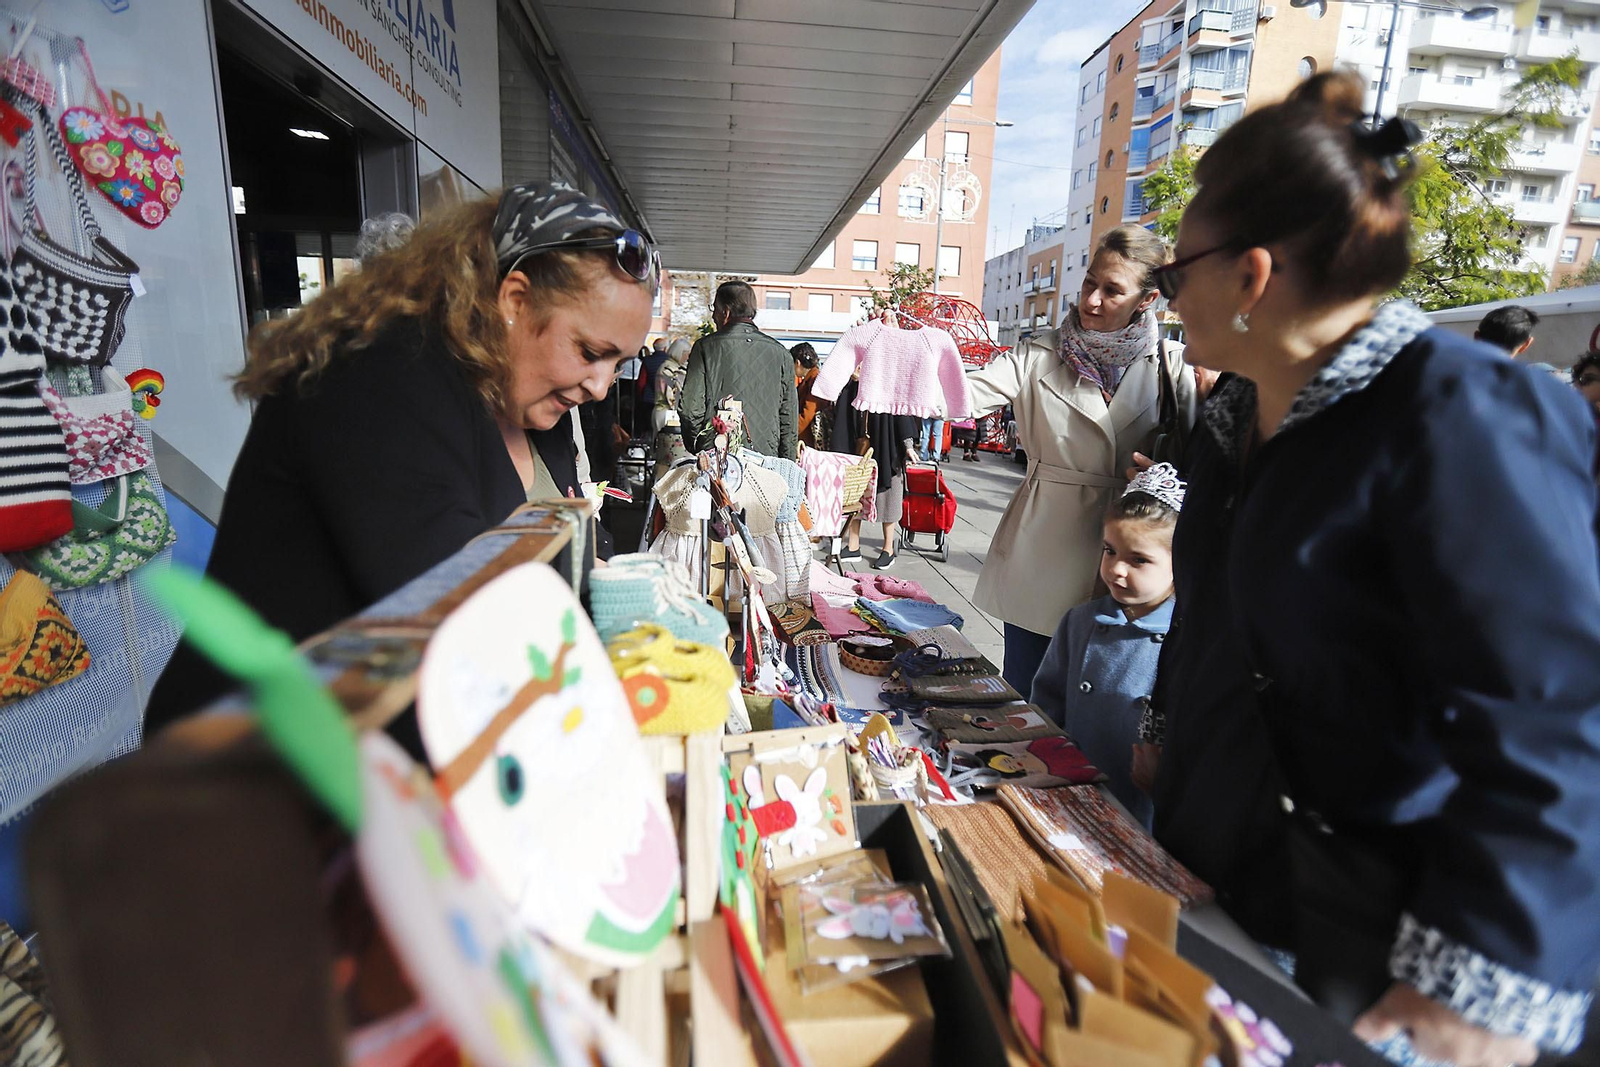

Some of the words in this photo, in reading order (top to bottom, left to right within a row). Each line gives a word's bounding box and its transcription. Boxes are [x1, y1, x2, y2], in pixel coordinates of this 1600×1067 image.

[296, 0, 428, 117] ainmobiliaria.com
[371, 0, 415, 60] SÁNCHEZ
[416, 50, 463, 108] CONSULTING
